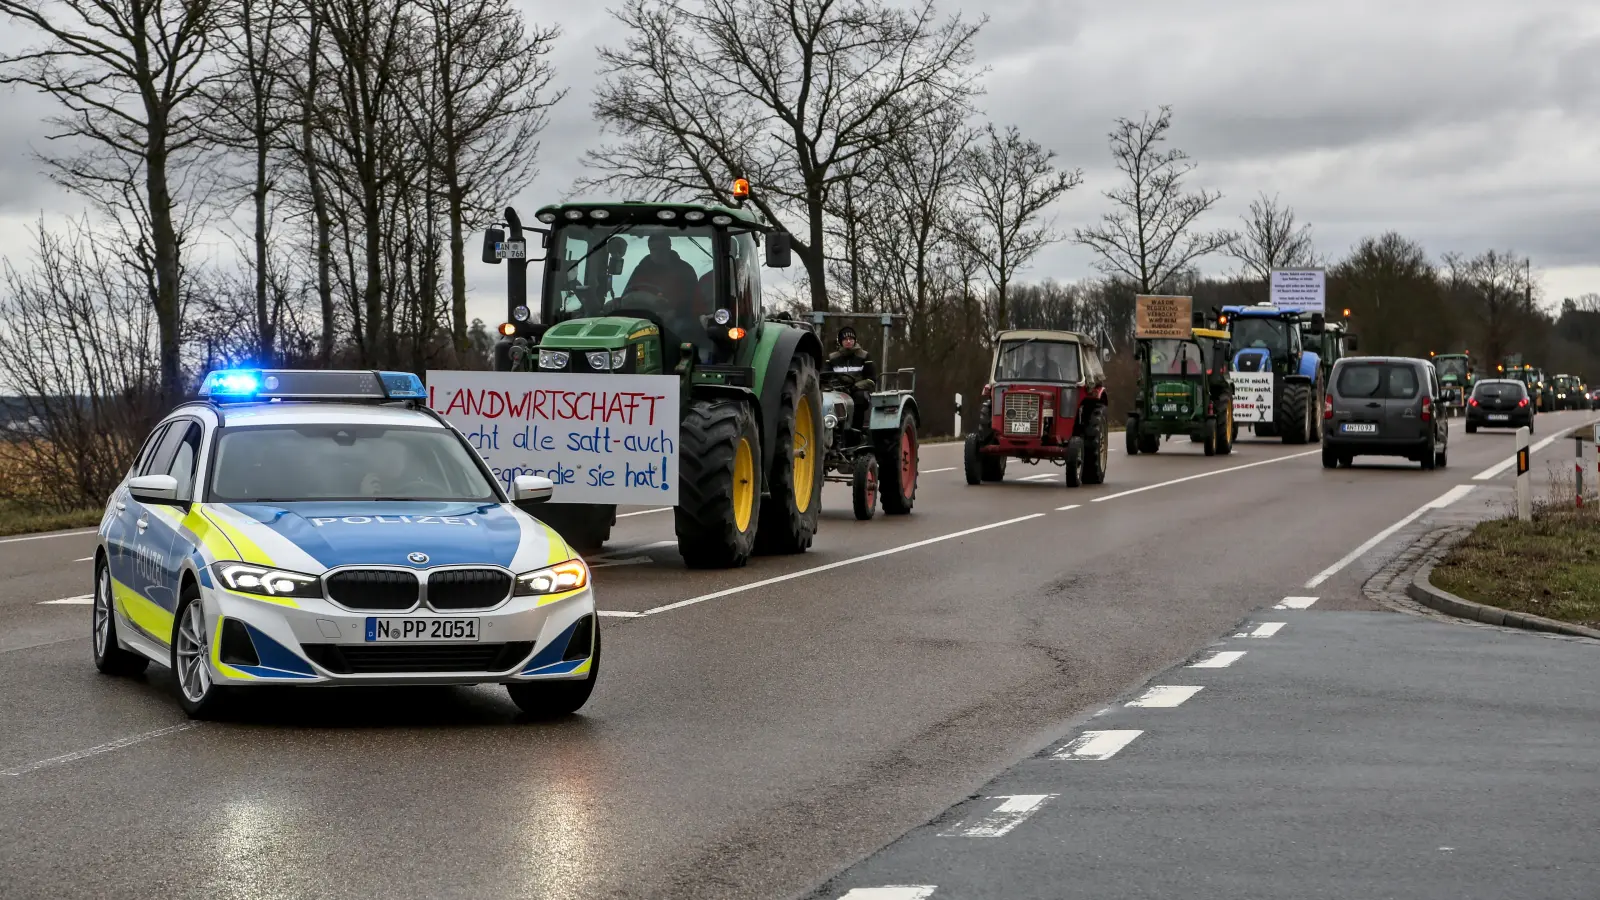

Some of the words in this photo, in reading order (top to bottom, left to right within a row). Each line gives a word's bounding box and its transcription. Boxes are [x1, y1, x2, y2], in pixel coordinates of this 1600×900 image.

[429, 386, 665, 425] LANDWIRTSCHAFT
[513, 425, 555, 451] alle
[547, 462, 575, 485] die
[586, 464, 615, 486] sie
[312, 516, 478, 527] POLIZEI
[136, 544, 164, 588] POLIZEI
[378, 621, 390, 638] N
[404, 621, 426, 638] PP
[431, 620, 476, 638] 2051
